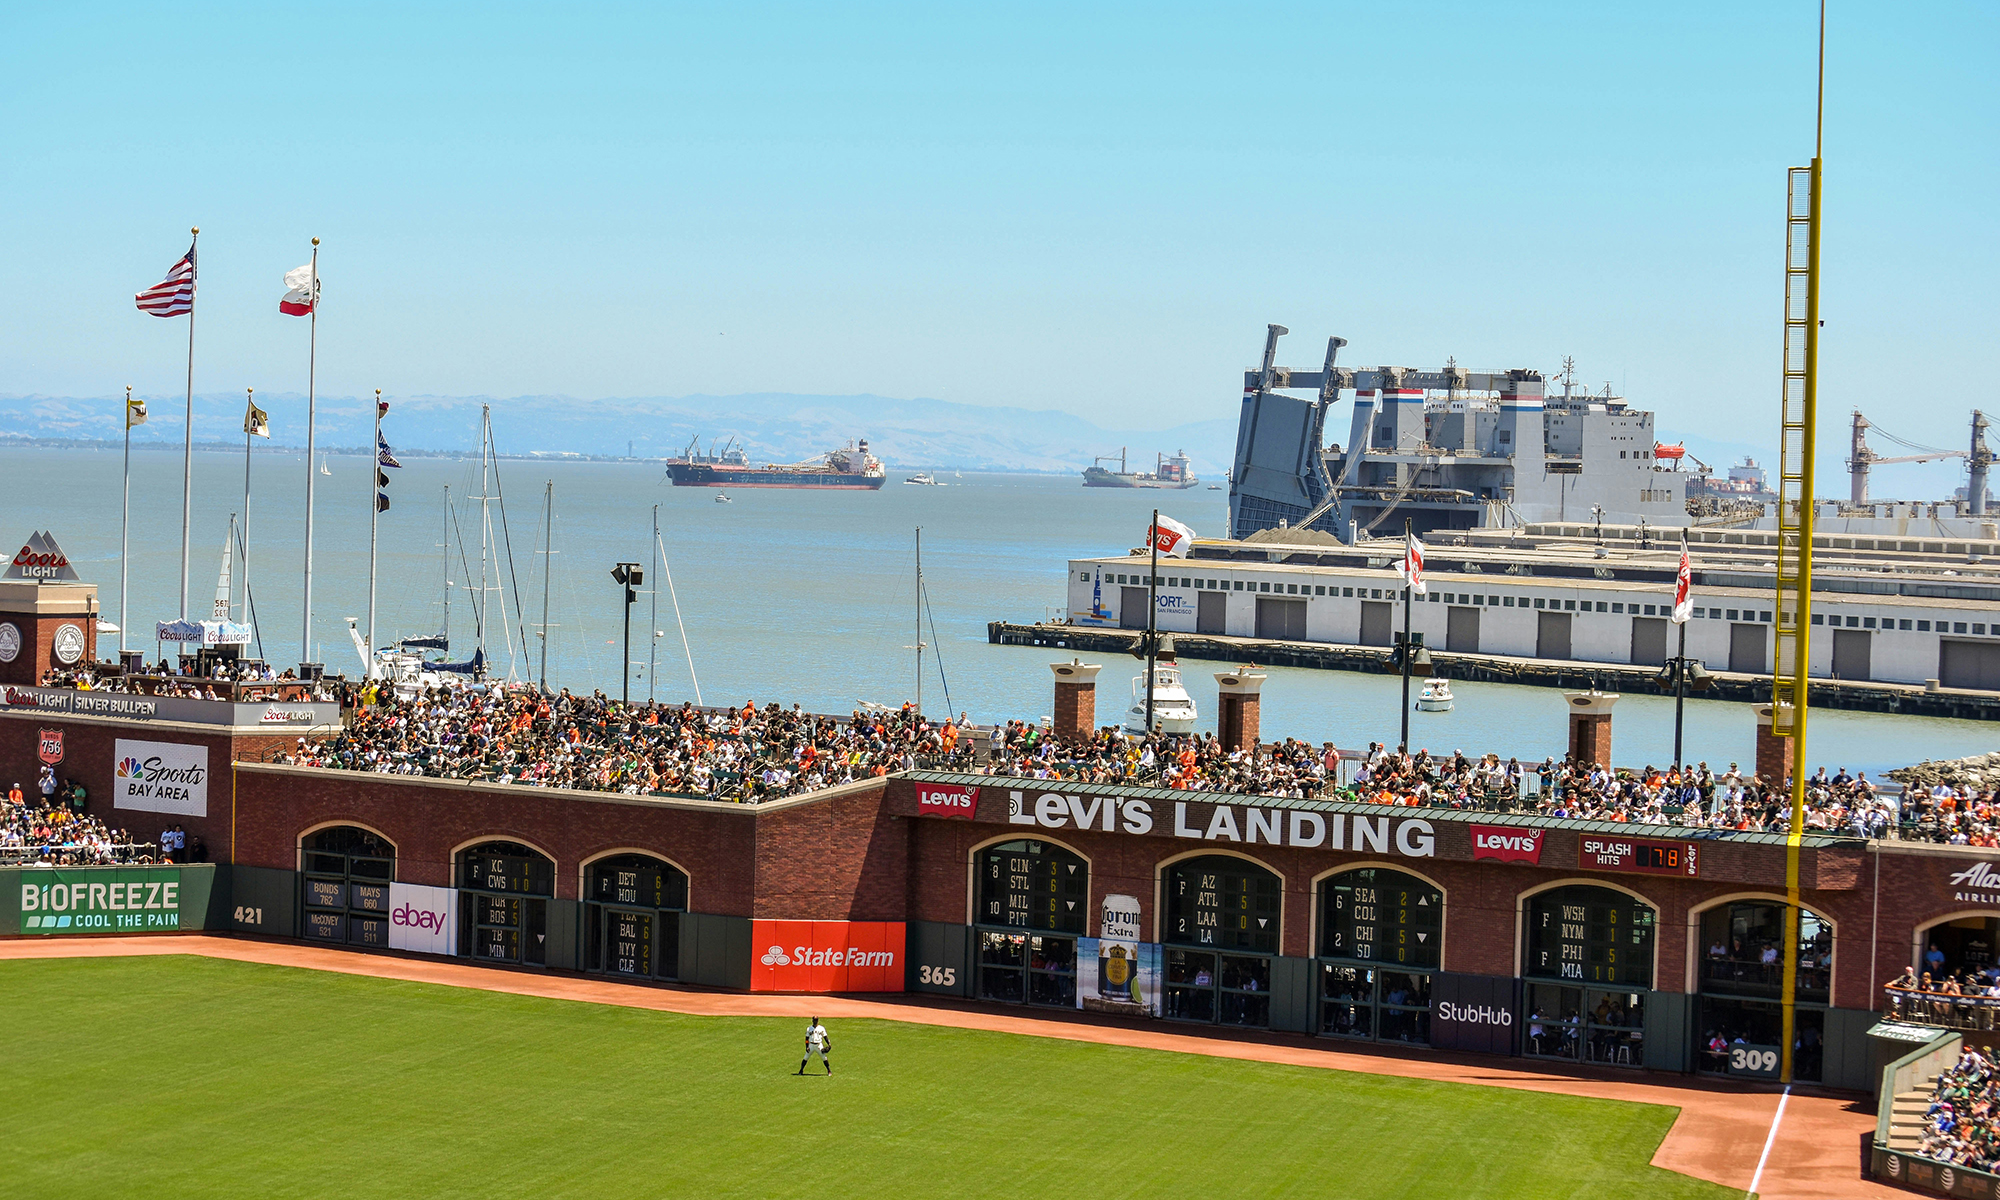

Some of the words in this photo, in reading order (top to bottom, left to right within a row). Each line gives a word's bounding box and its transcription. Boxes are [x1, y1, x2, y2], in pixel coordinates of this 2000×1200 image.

[13, 545, 68, 567] Coors
[22, 566, 59, 577] LIGHT
[1156, 595, 1182, 608] PORT
[160, 628, 182, 640] Coors
[182, 633, 201, 641] LIGHT
[208, 630, 229, 642] Coors
[230, 633, 249, 642] LIGHT
[6, 687, 38, 705] Coors
[38, 693, 69, 708] LIGHT
[75, 696, 109, 711] SILVER
[110, 698, 156, 715] BULLPEN
[264, 708, 291, 720] Coors
[291, 711, 316, 720] LIGHT
[41, 739, 61, 755] 756
[143, 756, 206, 788] Sports
[128, 783, 153, 797] BAY
[154, 785, 190, 801] AREA
[1174, 801, 1436, 858] LANDING
[1584, 840, 1632, 856] SPLASH
[1654, 848, 1678, 867] 78
[1596, 854, 1620, 866] HITS
[473, 865, 479, 878] F
[491, 859, 503, 873] KC
[524, 862, 529, 876] 1
[992, 865, 999, 879] 8
[1010, 858, 1029, 873] CIN
[1051, 861, 1057, 876] 3
[488, 875, 506, 890] CWS
[602, 878, 608, 891] F
[618, 872, 636, 887] DET
[655, 875, 661, 889] 6
[1010, 875, 1030, 890] STL
[1050, 878, 1057, 892] 6
[1180, 881, 1186, 895] F
[1201, 874, 1216, 889] AZ
[1242, 878, 1247, 892] 1
[314, 883, 339, 895] BONDS
[360, 887, 381, 899] MAYS
[618, 888, 636, 903] HOU
[655, 892, 661, 905] 3
[1355, 887, 1376, 903] SEA
[1400, 891, 1407, 906] 2
[319, 894, 333, 906] 762
[363, 898, 378, 909] 660
[990, 901, 1000, 915] 10
[1009, 894, 1028, 909] MIL
[1050, 898, 1056, 912] 6
[1197, 891, 1218, 907] ATL
[1241, 895, 1247, 910] 5
[1336, 895, 1343, 909] 6
[75, 914, 111, 927] COOL
[116, 914, 142, 927] THE
[147, 913, 178, 926] PAIN
[233, 906, 262, 925] 421
[311, 914, 339, 926] McCOVEY
[392, 902, 447, 935] ebay
[489, 910, 506, 924] BOS
[512, 912, 518, 925] 5
[1008, 911, 1028, 926] PIT
[1049, 915, 1055, 929] 5
[1197, 911, 1217, 927] LAA
[1240, 915, 1247, 929] 0
[1354, 905, 1376, 921] COL
[1399, 909, 1406, 924] 2
[1542, 912, 1549, 927] F
[1562, 905, 1585, 921] WSH
[1610, 909, 1617, 924] 6
[318, 926, 332, 937] 521
[363, 921, 377, 932] OTT
[620, 924, 636, 939] BAL
[643, 925, 649, 940] 6
[1107, 924, 1134, 937] Extra
[1179, 918, 1185, 932] 2
[1561, 923, 1584, 940] NYM
[1610, 928, 1615, 942] 1
[364, 933, 377, 943] 511
[492, 930, 503, 942] TB
[512, 931, 518, 943] 4
[1200, 929, 1213, 944] LA
[1335, 932, 1341, 947] 2
[1356, 925, 1374, 941] CHI
[1399, 929, 1405, 944] 5
[489, 944, 505, 958] MIN
[619, 942, 636, 957] NYY
[643, 945, 649, 958] 2
[1357, 943, 1371, 959] SD
[1398, 947, 1405, 962] 0
[1562, 944, 1582, 960] PHI
[1609, 948, 1615, 963] 5
[618, 959, 635, 973] CLE
[643, 963, 648, 974] 5
[1541, 951, 1548, 966] F
[919, 965, 956, 987] 365
[1561, 962, 1583, 979] MIA
[1438, 1001, 1512, 1027] StubHub
[1731, 1048, 1777, 1072] 309
